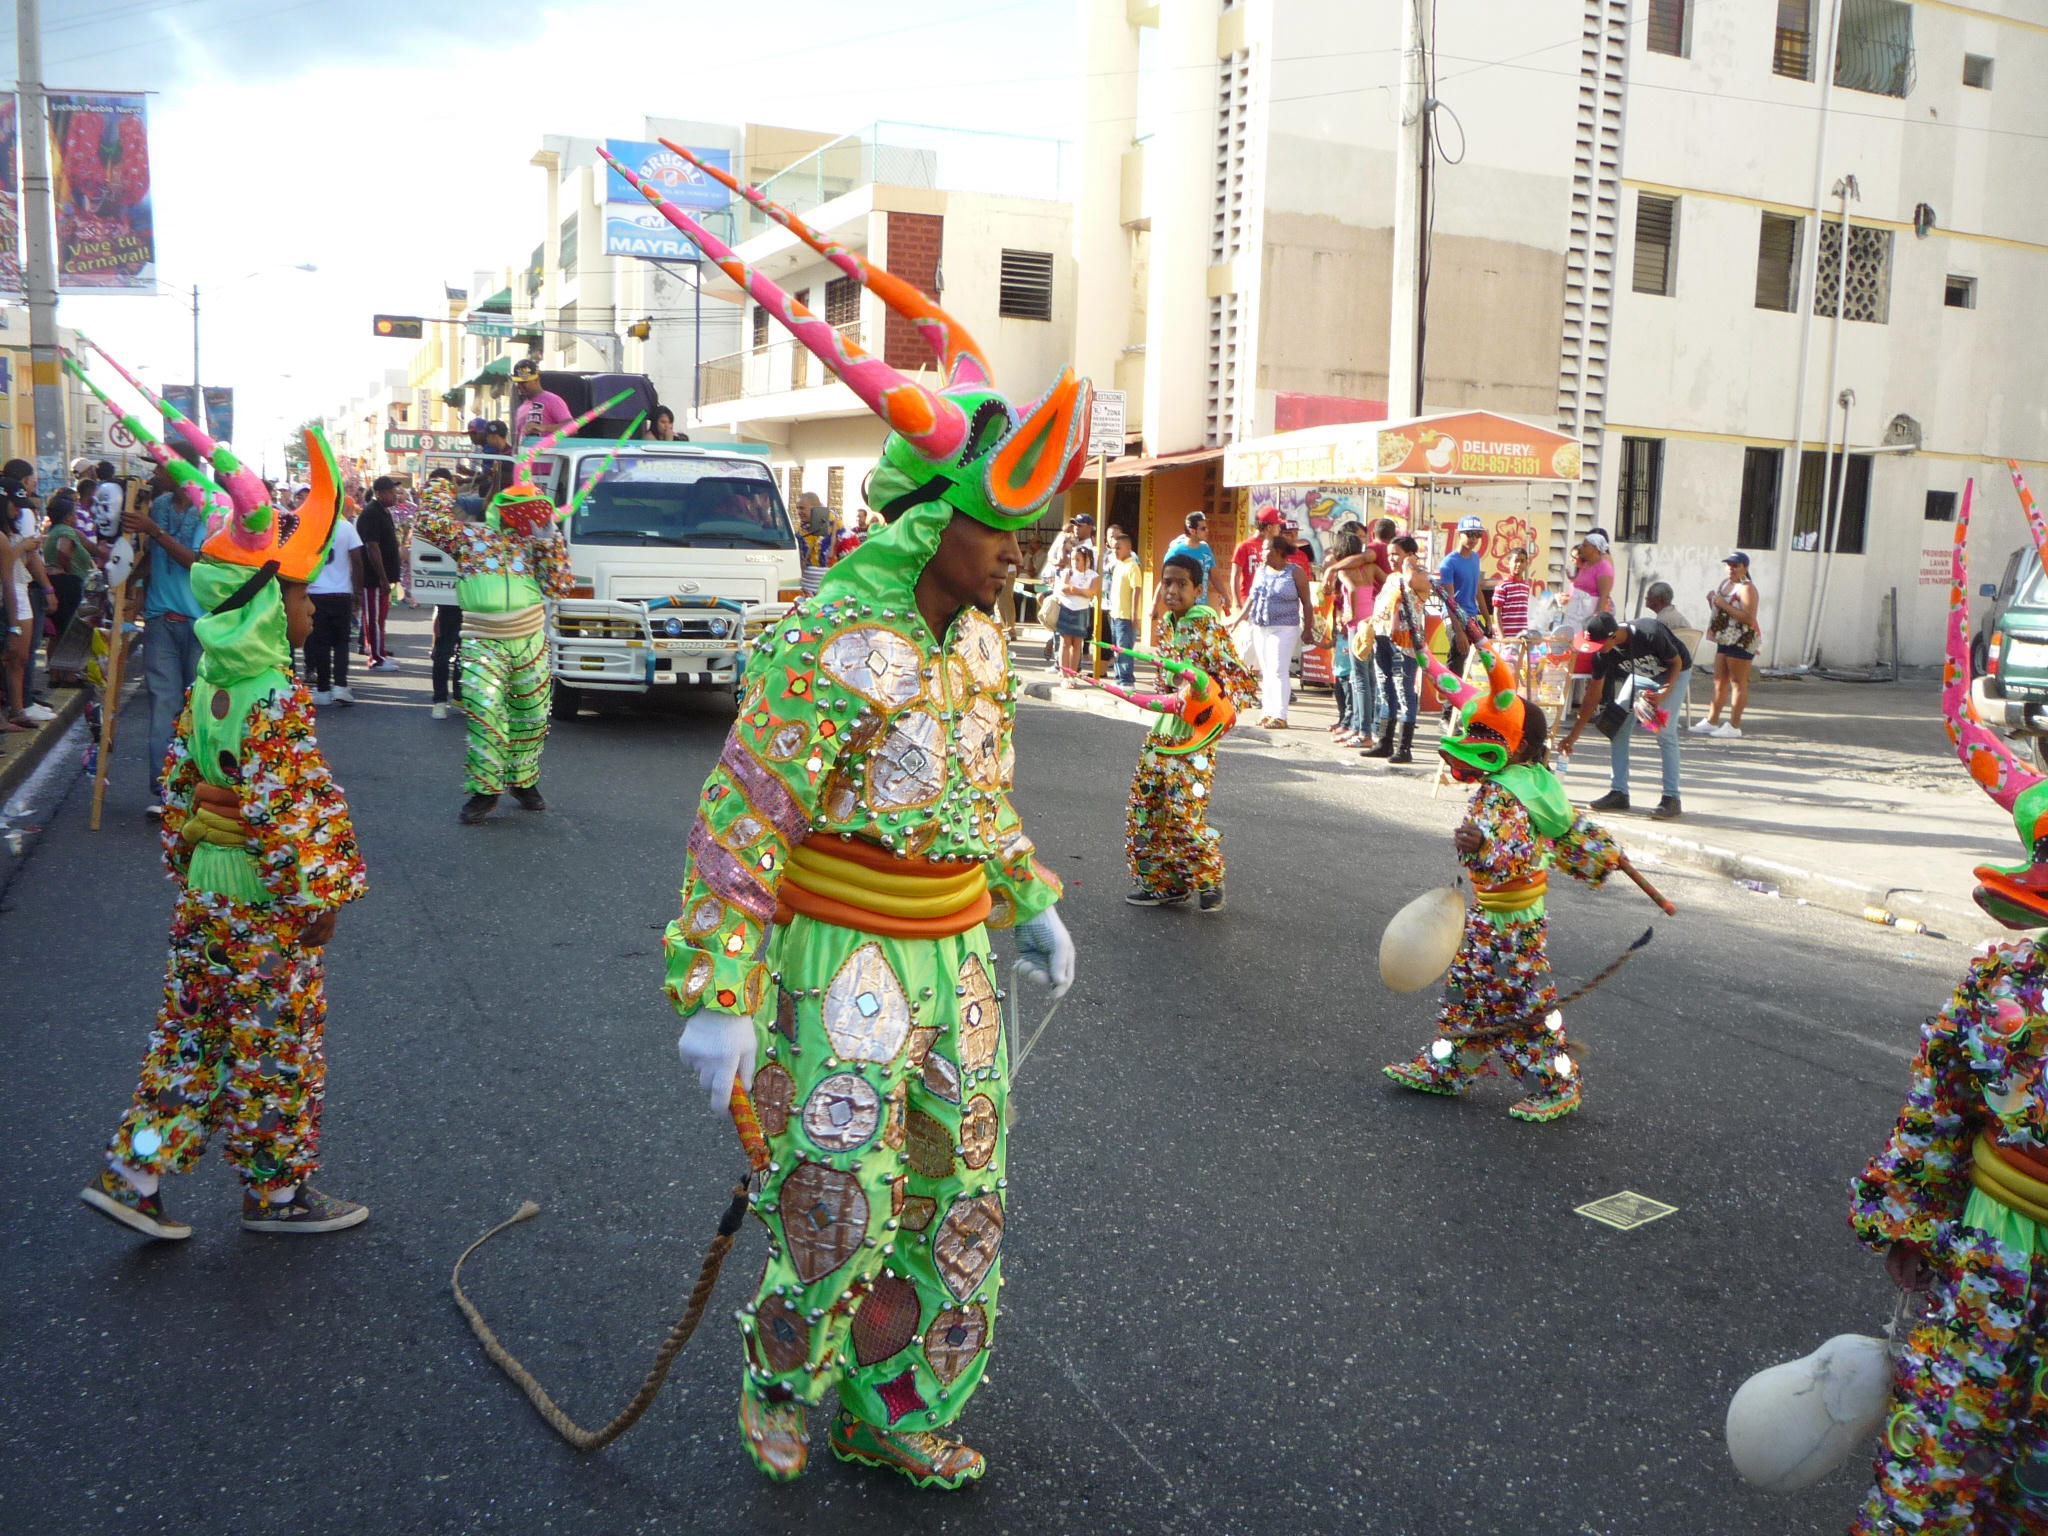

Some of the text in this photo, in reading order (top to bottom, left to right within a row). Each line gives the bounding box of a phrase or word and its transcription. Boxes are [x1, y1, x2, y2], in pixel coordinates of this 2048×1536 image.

[639, 153, 701, 185] BRUGAL
[69, 236, 137, 256] Vive tu
[609, 237, 695, 256] MAYRA
[64, 247, 151, 273] Carnaval!
[1463, 440, 1529, 456] DELIVERY
[1462, 453, 1541, 475] 829-857-5131
